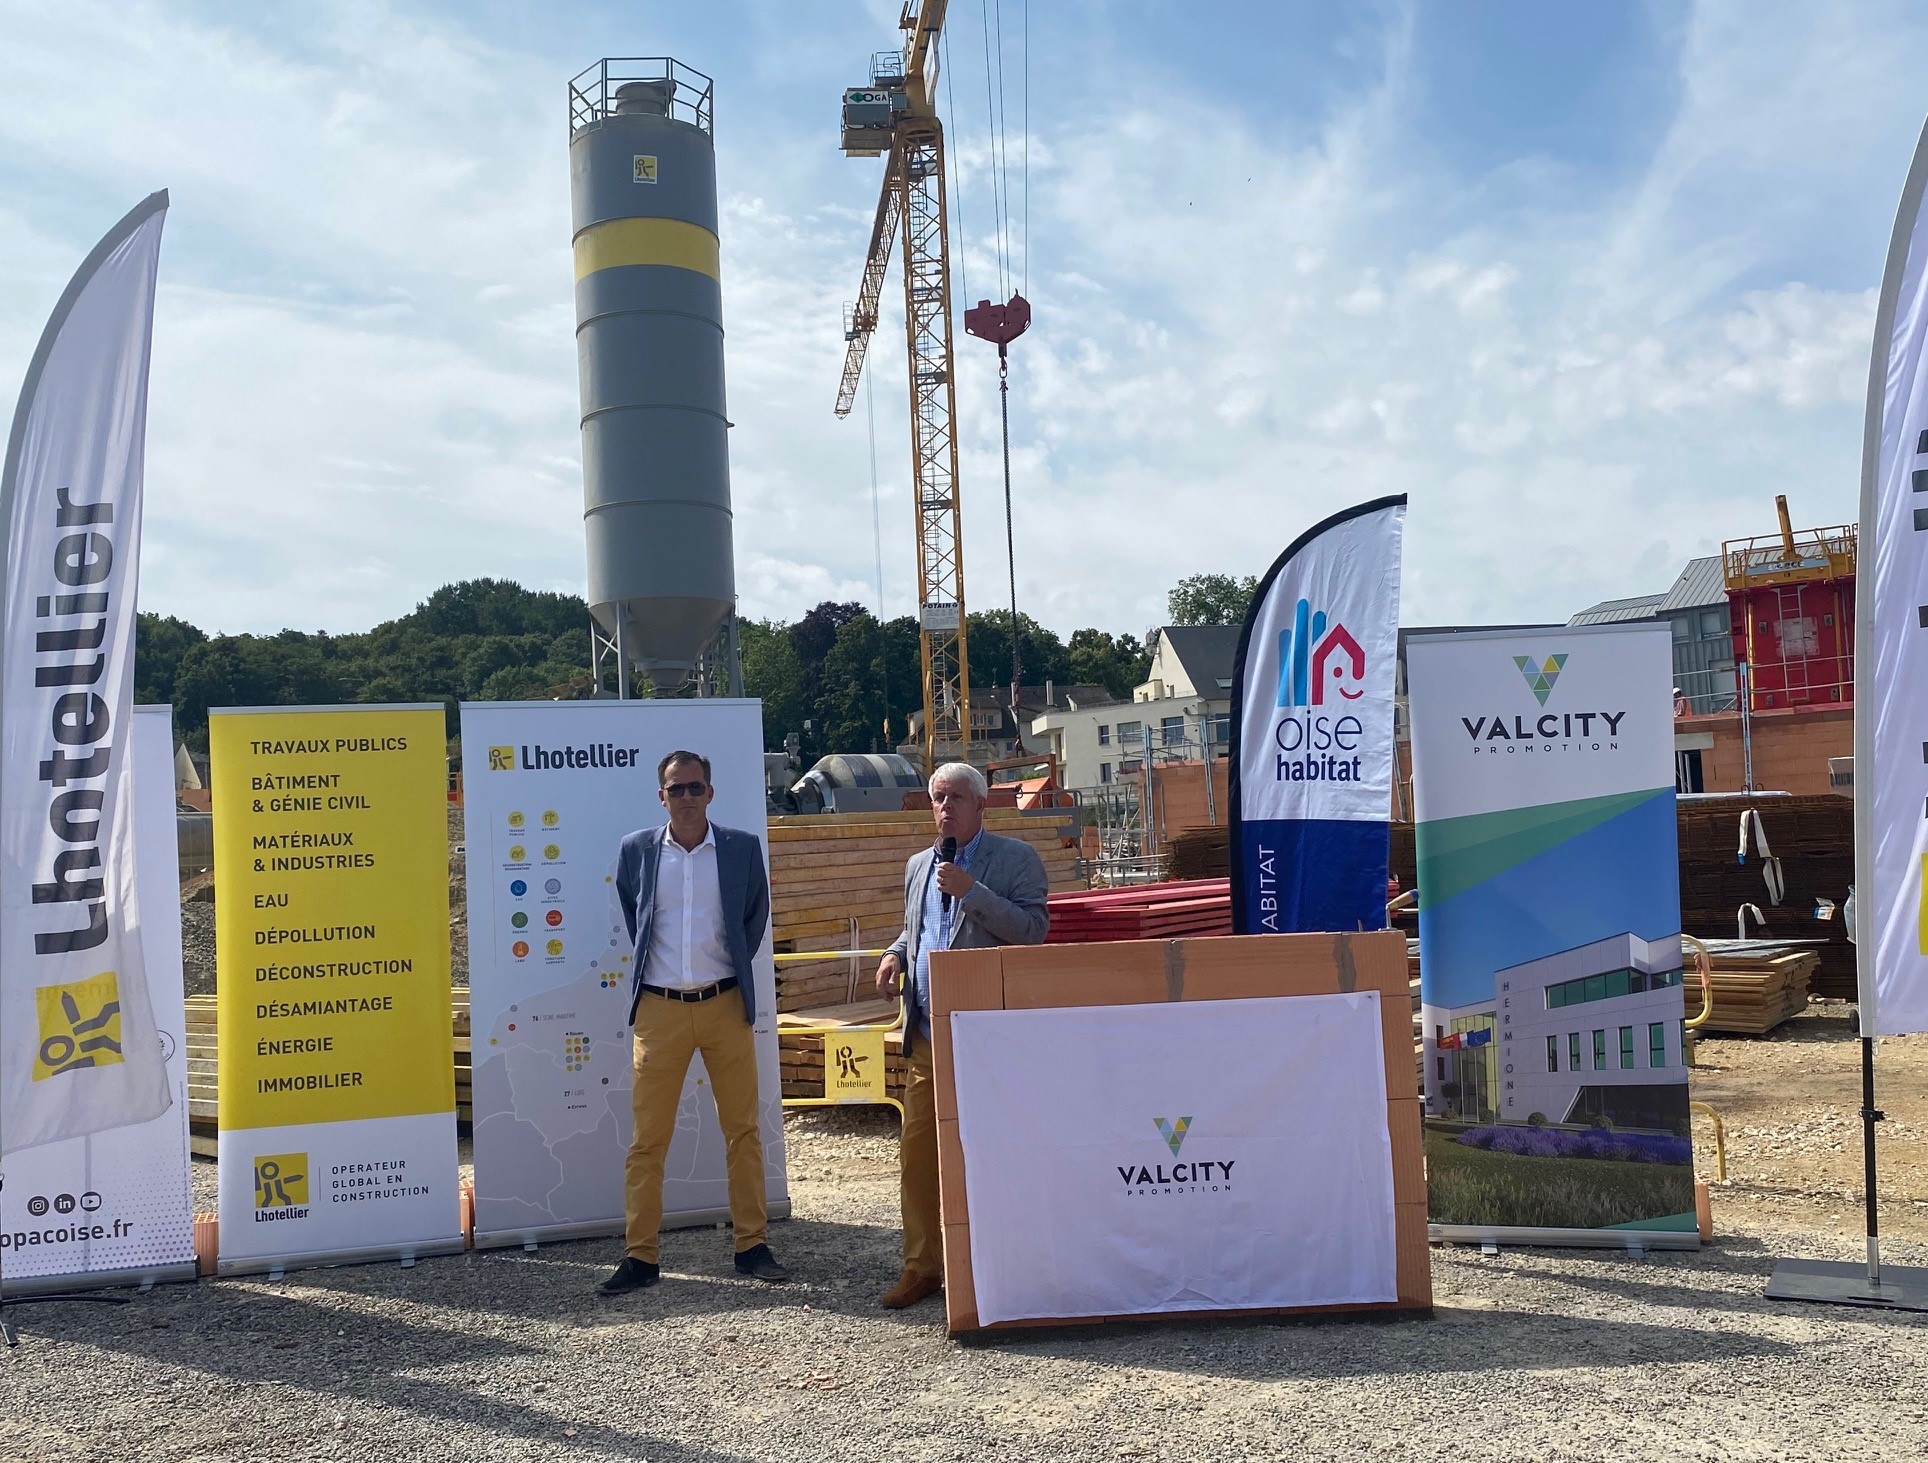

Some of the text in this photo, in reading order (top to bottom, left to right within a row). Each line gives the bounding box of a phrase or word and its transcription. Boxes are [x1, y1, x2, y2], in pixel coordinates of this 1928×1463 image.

[32, 487, 114, 955] Lhotellier
[1276, 709, 1363, 751] oise
[1461, 711, 1626, 741] VALCITY
[250, 737, 408, 755] TRAVAUX PUBLICS
[1473, 742, 1618, 754] PROMOTION
[521, 743, 640, 770] Lhotellier
[1276, 753, 1362, 782] habitat
[251, 773, 340, 791] BÂTIMENT
[252, 794, 371, 812] & GÉNIE CIVIL
[253, 831, 354, 849] MATÉRIAUX
[253, 853, 375, 872] & INDUSTRIES
[1259, 844, 1278, 931] ABITAT
[254, 893, 289, 909] EAU
[255, 925, 376, 945] DÉPOLLUTION
[255, 959, 412, 982] DÉCONSTRUCTION
[256, 996, 393, 1019] DÉSAMIANTAGE
[257, 1037, 334, 1056] ÉNERGIE
[257, 1072, 363, 1094] IMMOBILIER
[836, 1080, 872, 1088] Lhotellier
[331, 1160, 406, 1175] OPERATEUR
[1117, 1160, 1235, 1185] VALCITY
[332, 1174, 403, 1189] GLOBAL EN
[1127, 1185, 1231, 1196] PROMOTION
[332, 1186, 429, 1202] CONSTRUCTION
[254, 1207, 310, 1223] Lhotellier
[0, 1219, 134, 1252] opacoise.fr
